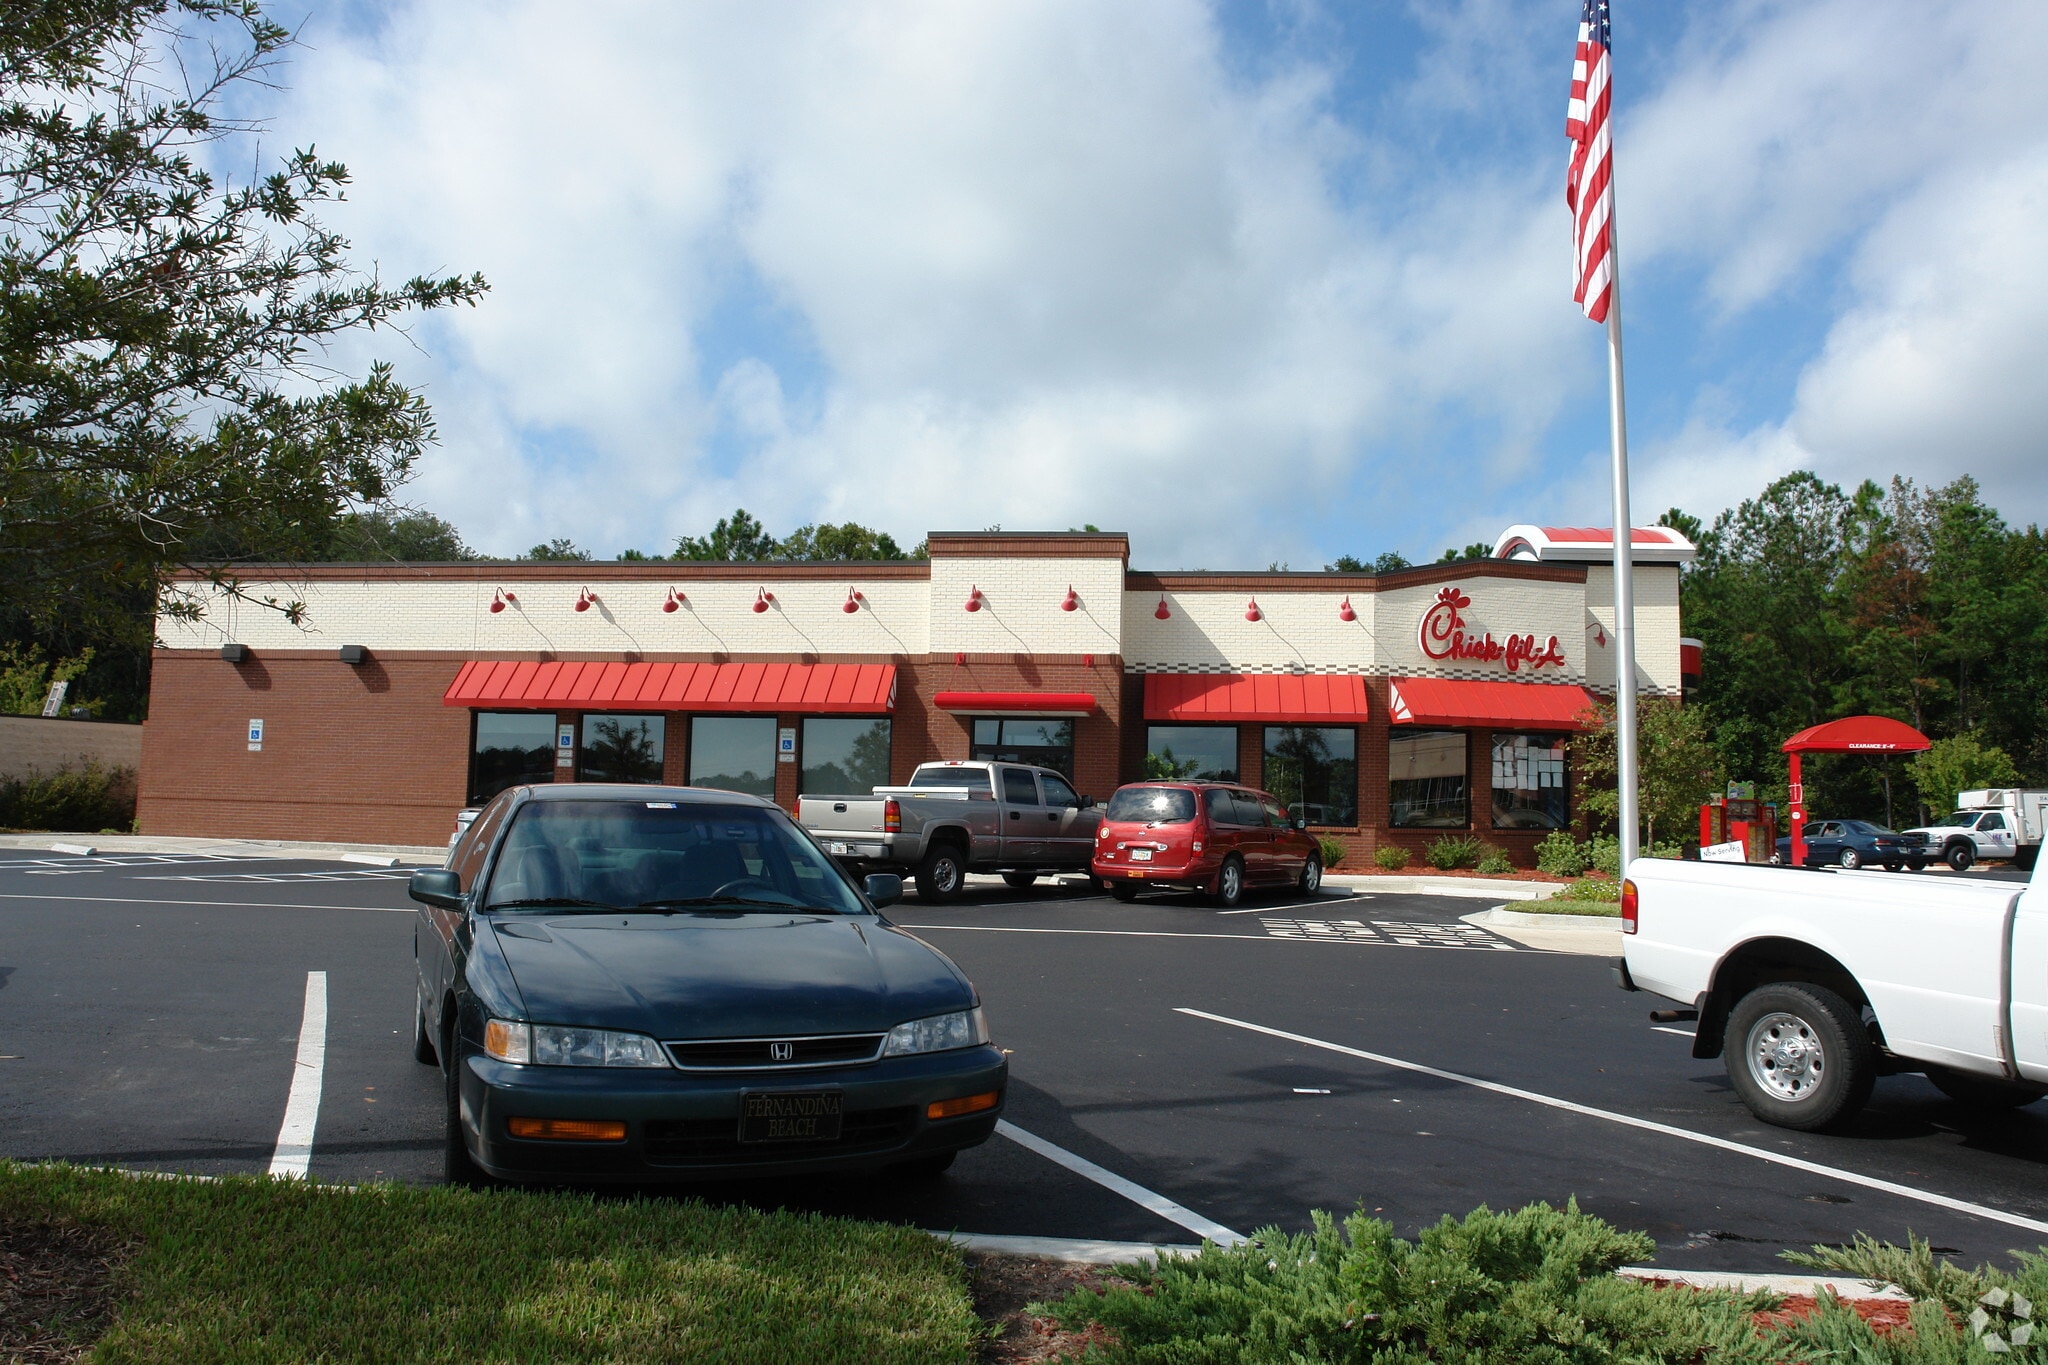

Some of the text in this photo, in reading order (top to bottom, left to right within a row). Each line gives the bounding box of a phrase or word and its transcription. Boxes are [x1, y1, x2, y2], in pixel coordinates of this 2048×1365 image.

[1418, 588, 1566, 672] Chick-fil-A
[747, 1096, 840, 1117] FERNANDINA
[767, 1118, 818, 1137] BEACH
